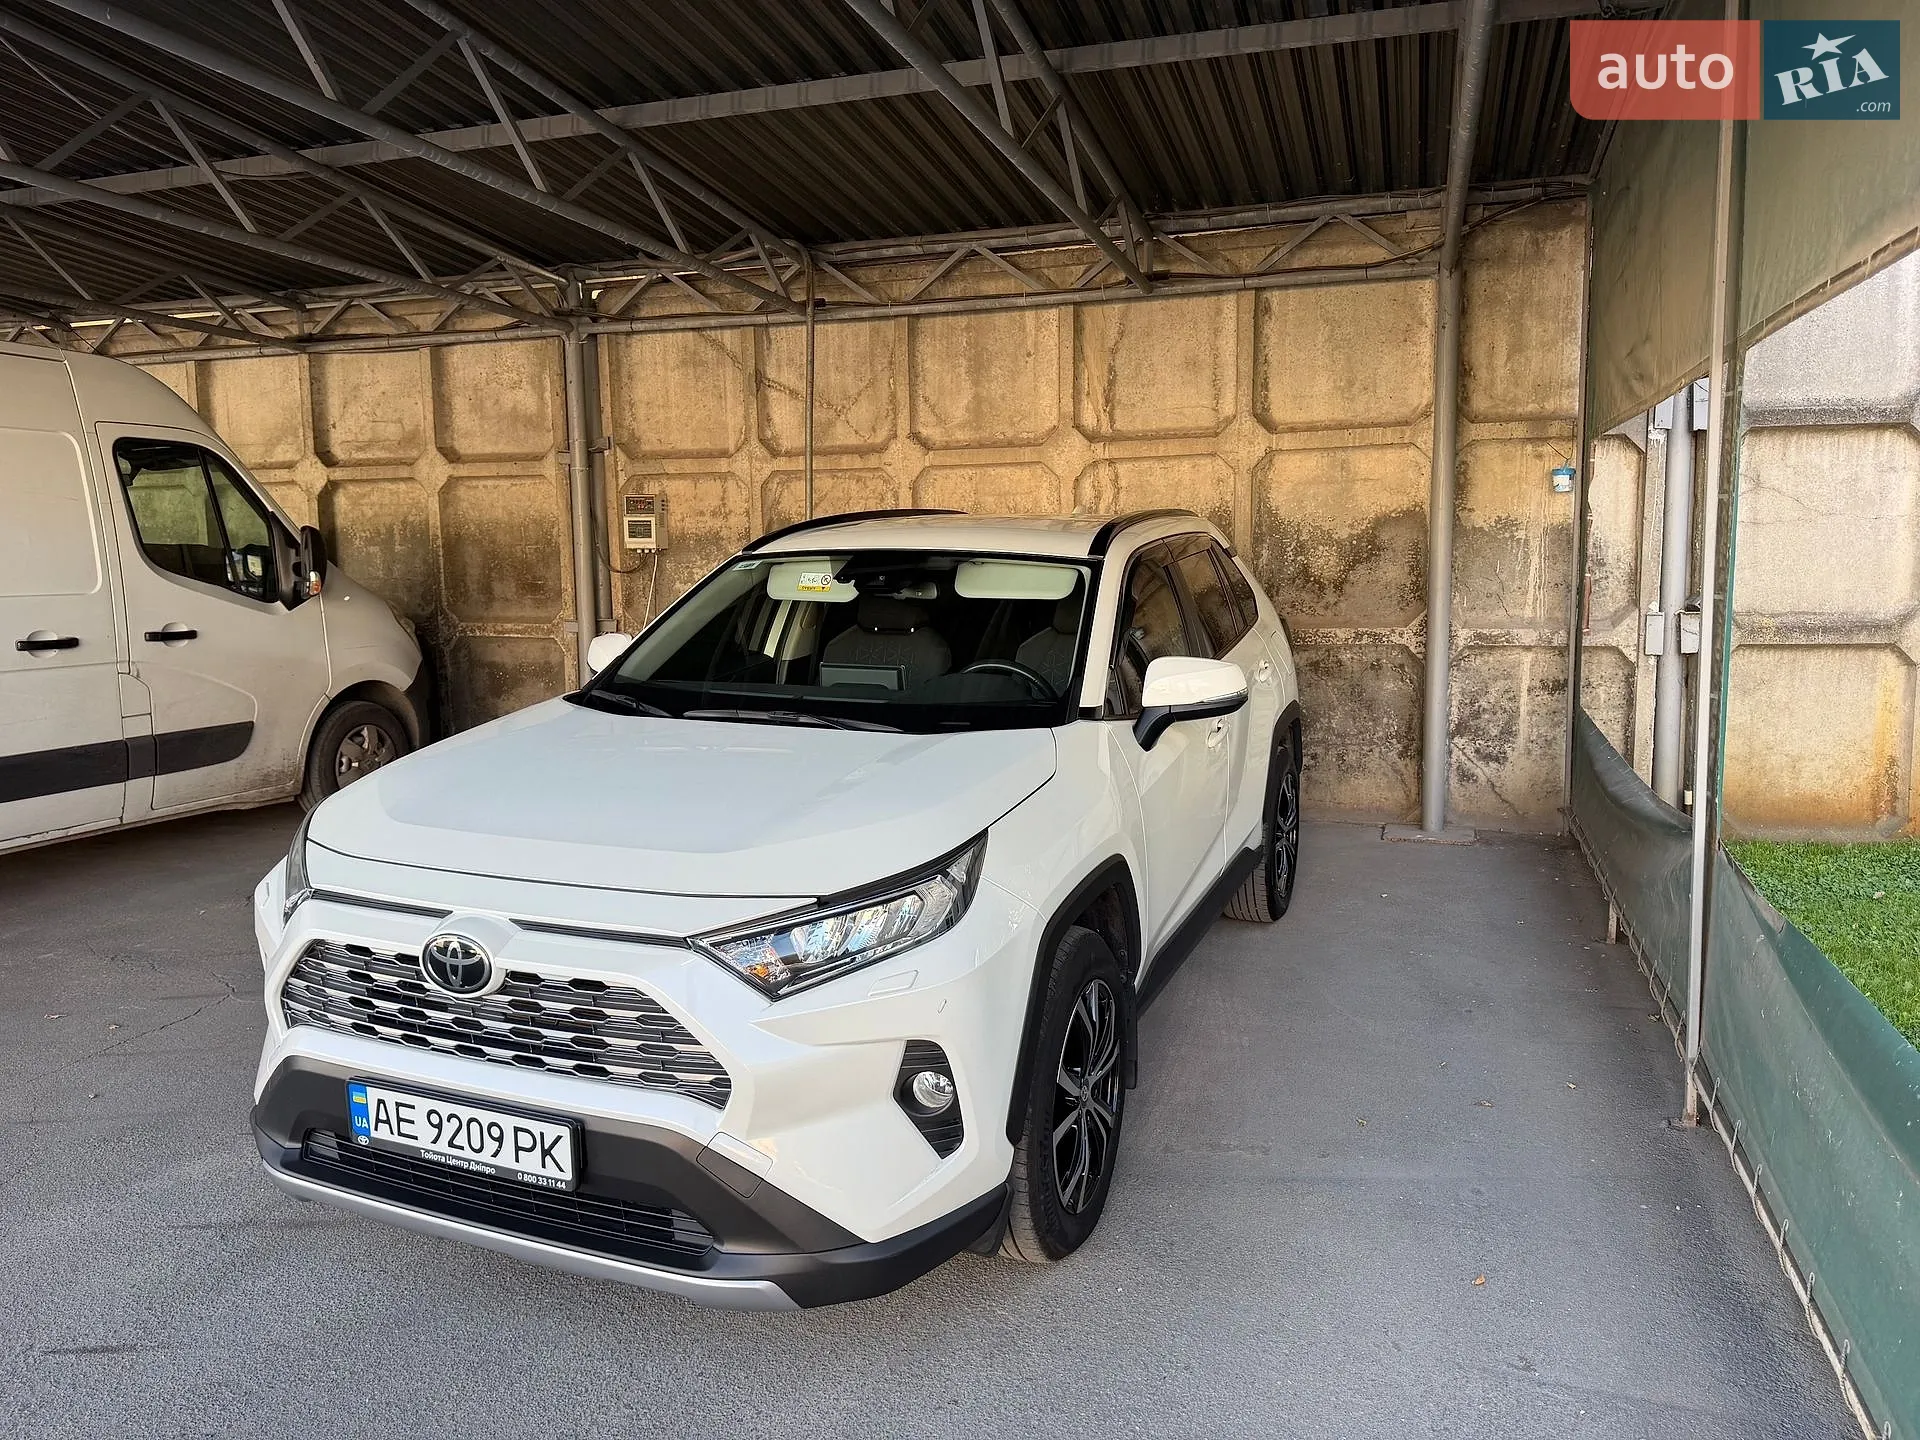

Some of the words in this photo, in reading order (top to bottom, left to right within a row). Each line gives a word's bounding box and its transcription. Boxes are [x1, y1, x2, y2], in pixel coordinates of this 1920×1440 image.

[354, 1115, 369, 1129] UA
[373, 1098, 419, 1140] AE
[426, 1108, 505, 1158] 9209
[512, 1125, 566, 1173] PK
[420, 1149, 446, 1163] Тойота
[446, 1155, 469, 1170] Центр
[469, 1161, 496, 1175] Дніпро
